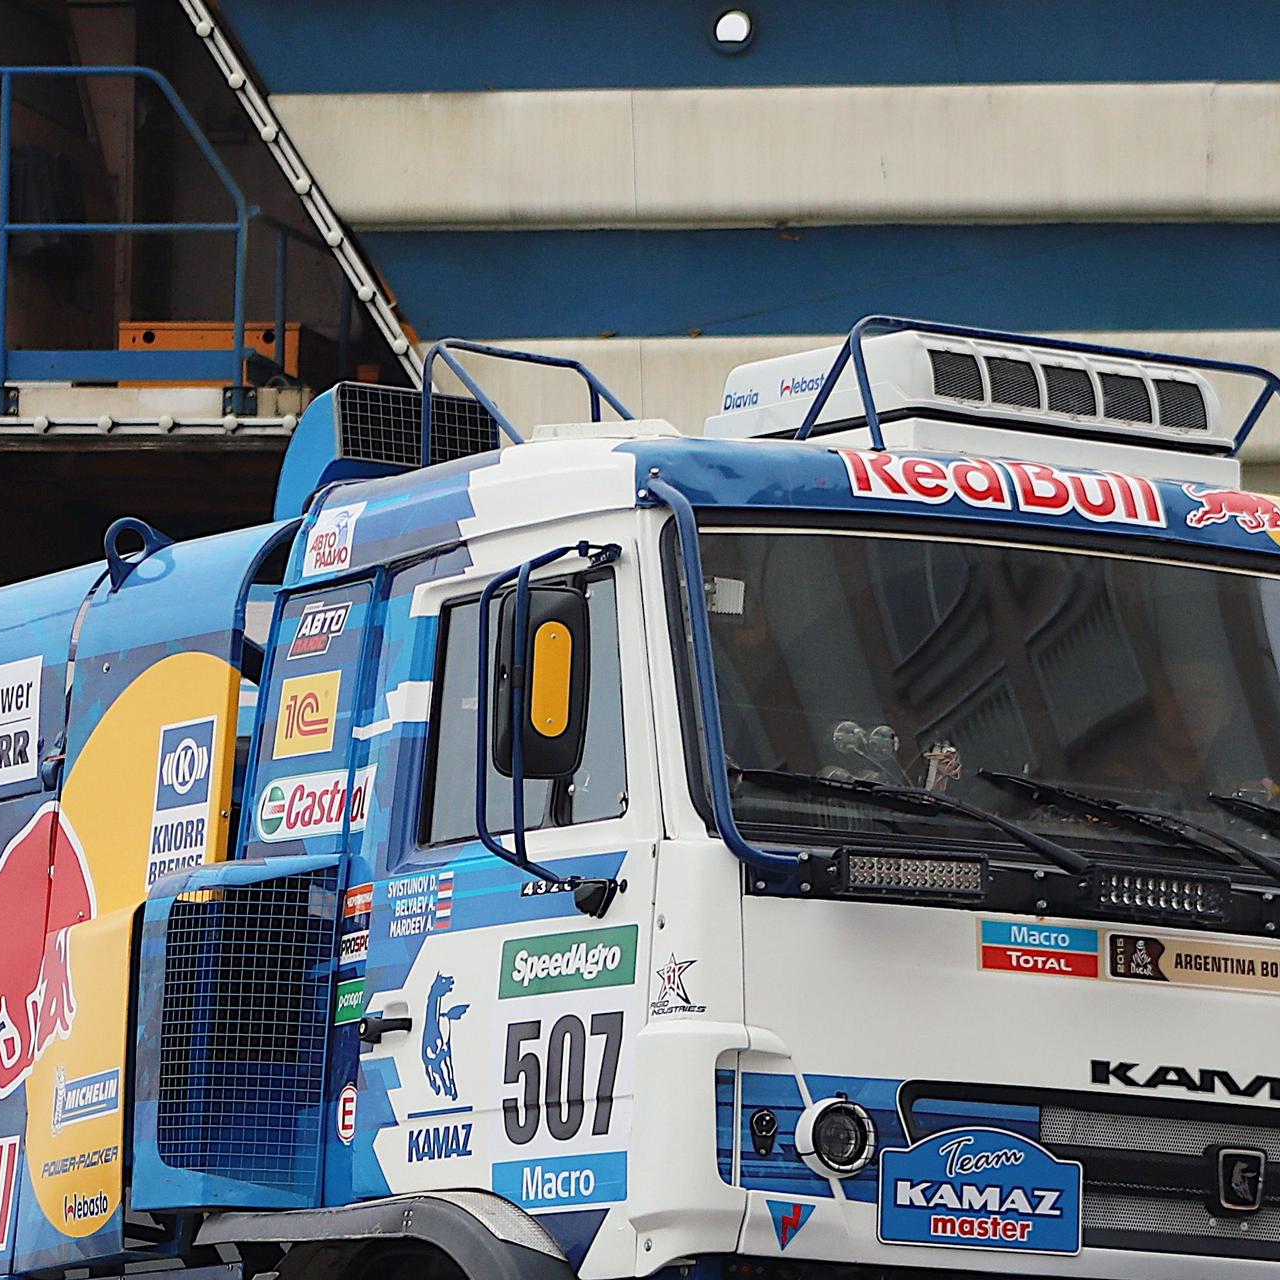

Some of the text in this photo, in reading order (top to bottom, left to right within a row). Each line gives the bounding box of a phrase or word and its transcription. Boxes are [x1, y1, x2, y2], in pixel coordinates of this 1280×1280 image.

[723, 389, 759, 411] Diavia
[780, 373, 826, 398] Webast
[309, 531, 337, 552] АВТО
[314, 547, 348, 569] РАДИО
[297, 608, 347, 638] АВТО
[285, 776, 368, 831] Castrol
[151, 818, 205, 854] KNORR
[387, 877, 428, 899] SVISTUNOV
[395, 896, 426, 917] BELYAEV
[389, 914, 426, 938] MARDEEV
[1010, 926, 1070, 947] Macro
[511, 942, 622, 987] SpeedAgro
[1006, 951, 1073, 972] TOTAL
[1116, 938, 1125, 974] 2015
[1173, 952, 1256, 976] ARGENTINA
[502, 1010, 625, 1145] 507
[64, 1078, 118, 1111] MICHELIN
[407, 1123, 473, 1163] KAMAZ
[939, 1136, 1024, 1178] Team
[41, 1145, 119, 1179] POWER-PACKER
[521, 1165, 596, 1202] Macro
[894, 1180, 1063, 1217] KAMAZ
[64, 1190, 108, 1224] Webasto
[930, 1213, 1032, 1242] master
